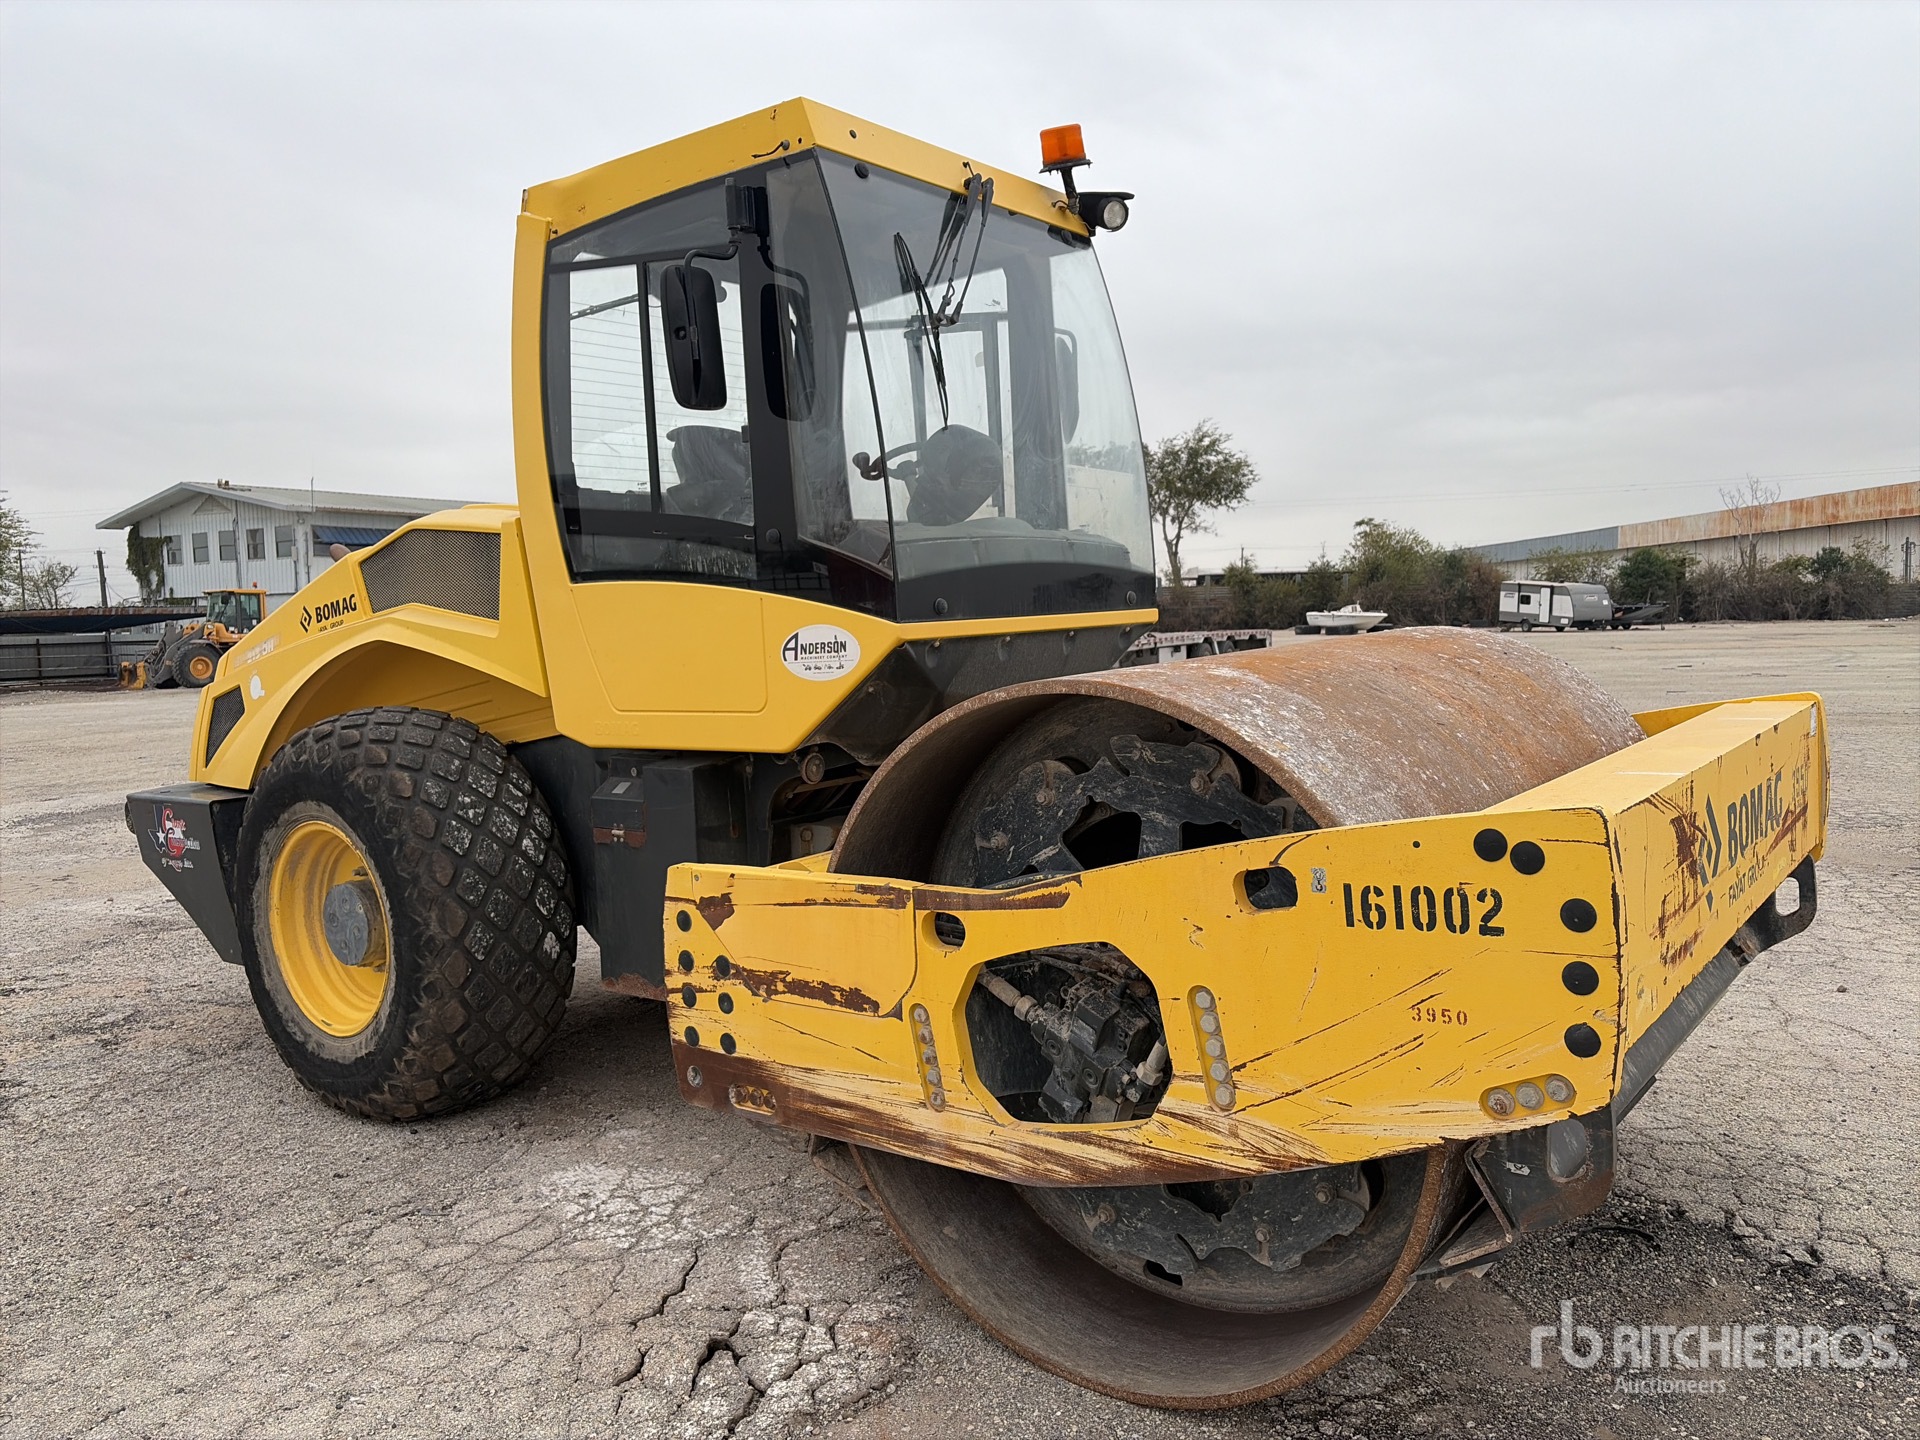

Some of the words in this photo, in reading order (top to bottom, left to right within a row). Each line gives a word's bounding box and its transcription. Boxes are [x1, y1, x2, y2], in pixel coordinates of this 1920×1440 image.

[315, 594, 357, 624] BOMAG
[782, 632, 847, 662] ANDERSON
[1727, 769, 1783, 871] BOMAG
[1728, 871, 1746, 908] FAYAT
[1343, 883, 1505, 937] 161002
[1411, 1006, 1468, 1026] 3950
